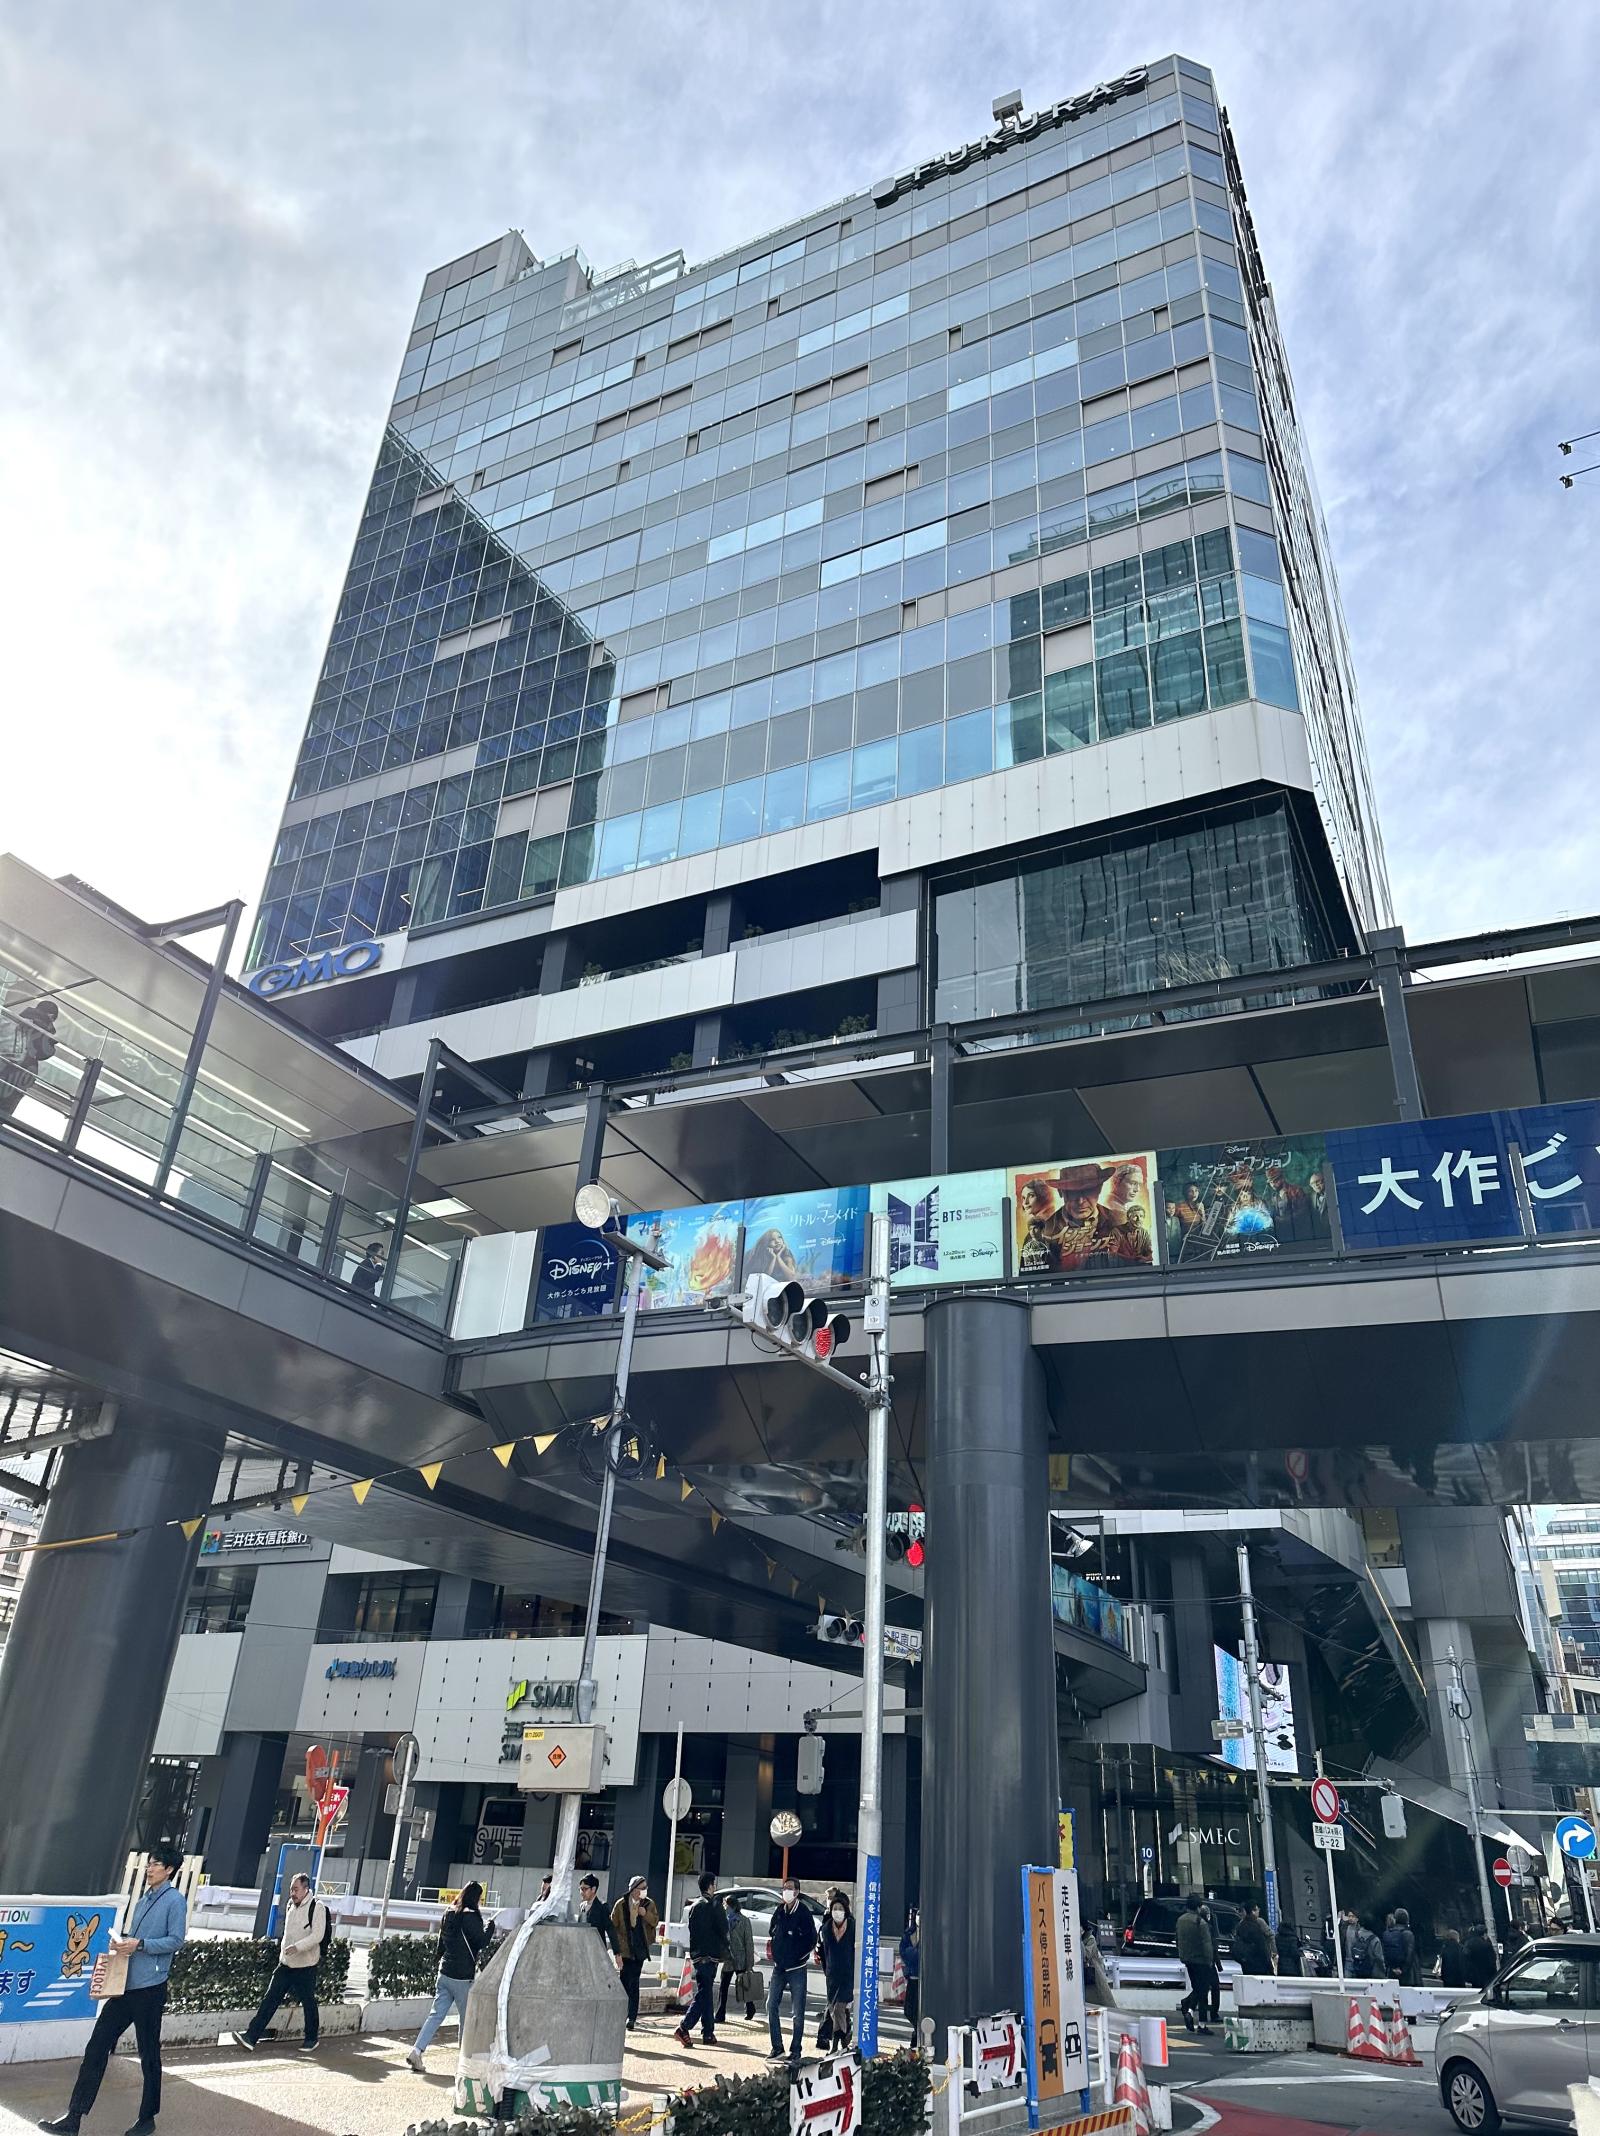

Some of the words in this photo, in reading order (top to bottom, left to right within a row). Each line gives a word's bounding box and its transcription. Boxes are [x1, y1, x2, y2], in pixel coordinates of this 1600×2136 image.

[914, 64, 1148, 182] FUKURAS
[249, 941, 383, 997] GMO
[1357, 1132, 1600, 1216] 大作ご
[942, 1209, 962, 1223] BTS
[547, 1257, 615, 1281] Disney+
[1141, 1847, 1153, 1858] 10
[1320, 1837, 1340, 1848] 6-22
[1037, 1882, 1051, 2008] バス停留所
[1061, 1885, 1074, 1982] 走行車線
[91, 1960, 109, 1995] VELOCE
